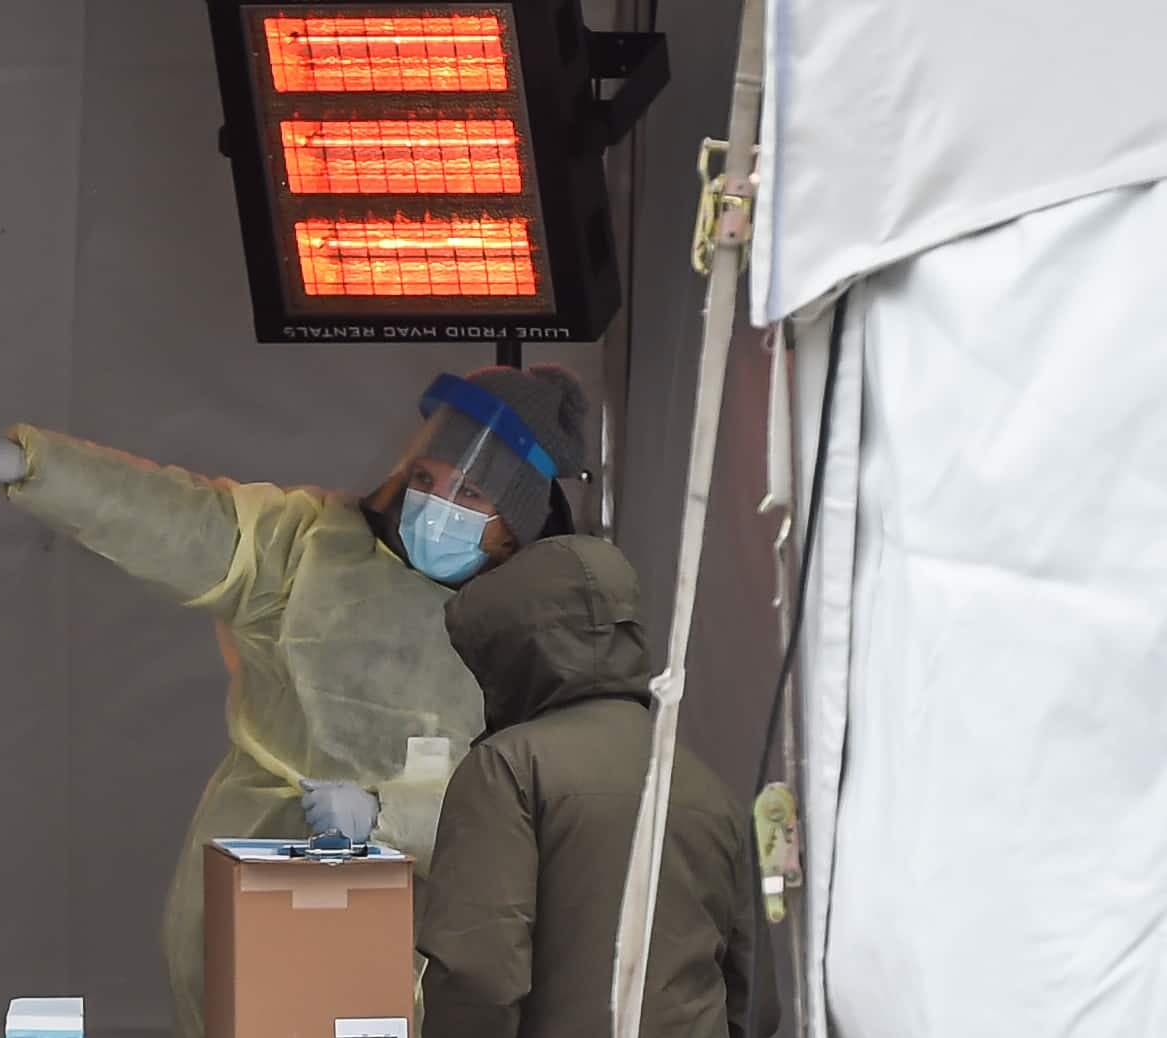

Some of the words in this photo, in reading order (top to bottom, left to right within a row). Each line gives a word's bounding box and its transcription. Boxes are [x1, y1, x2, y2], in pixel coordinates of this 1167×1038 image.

[283, 325, 376, 338] RENTALS
[382, 325, 438, 338] HVAC
[444, 325, 508, 338] FROID
